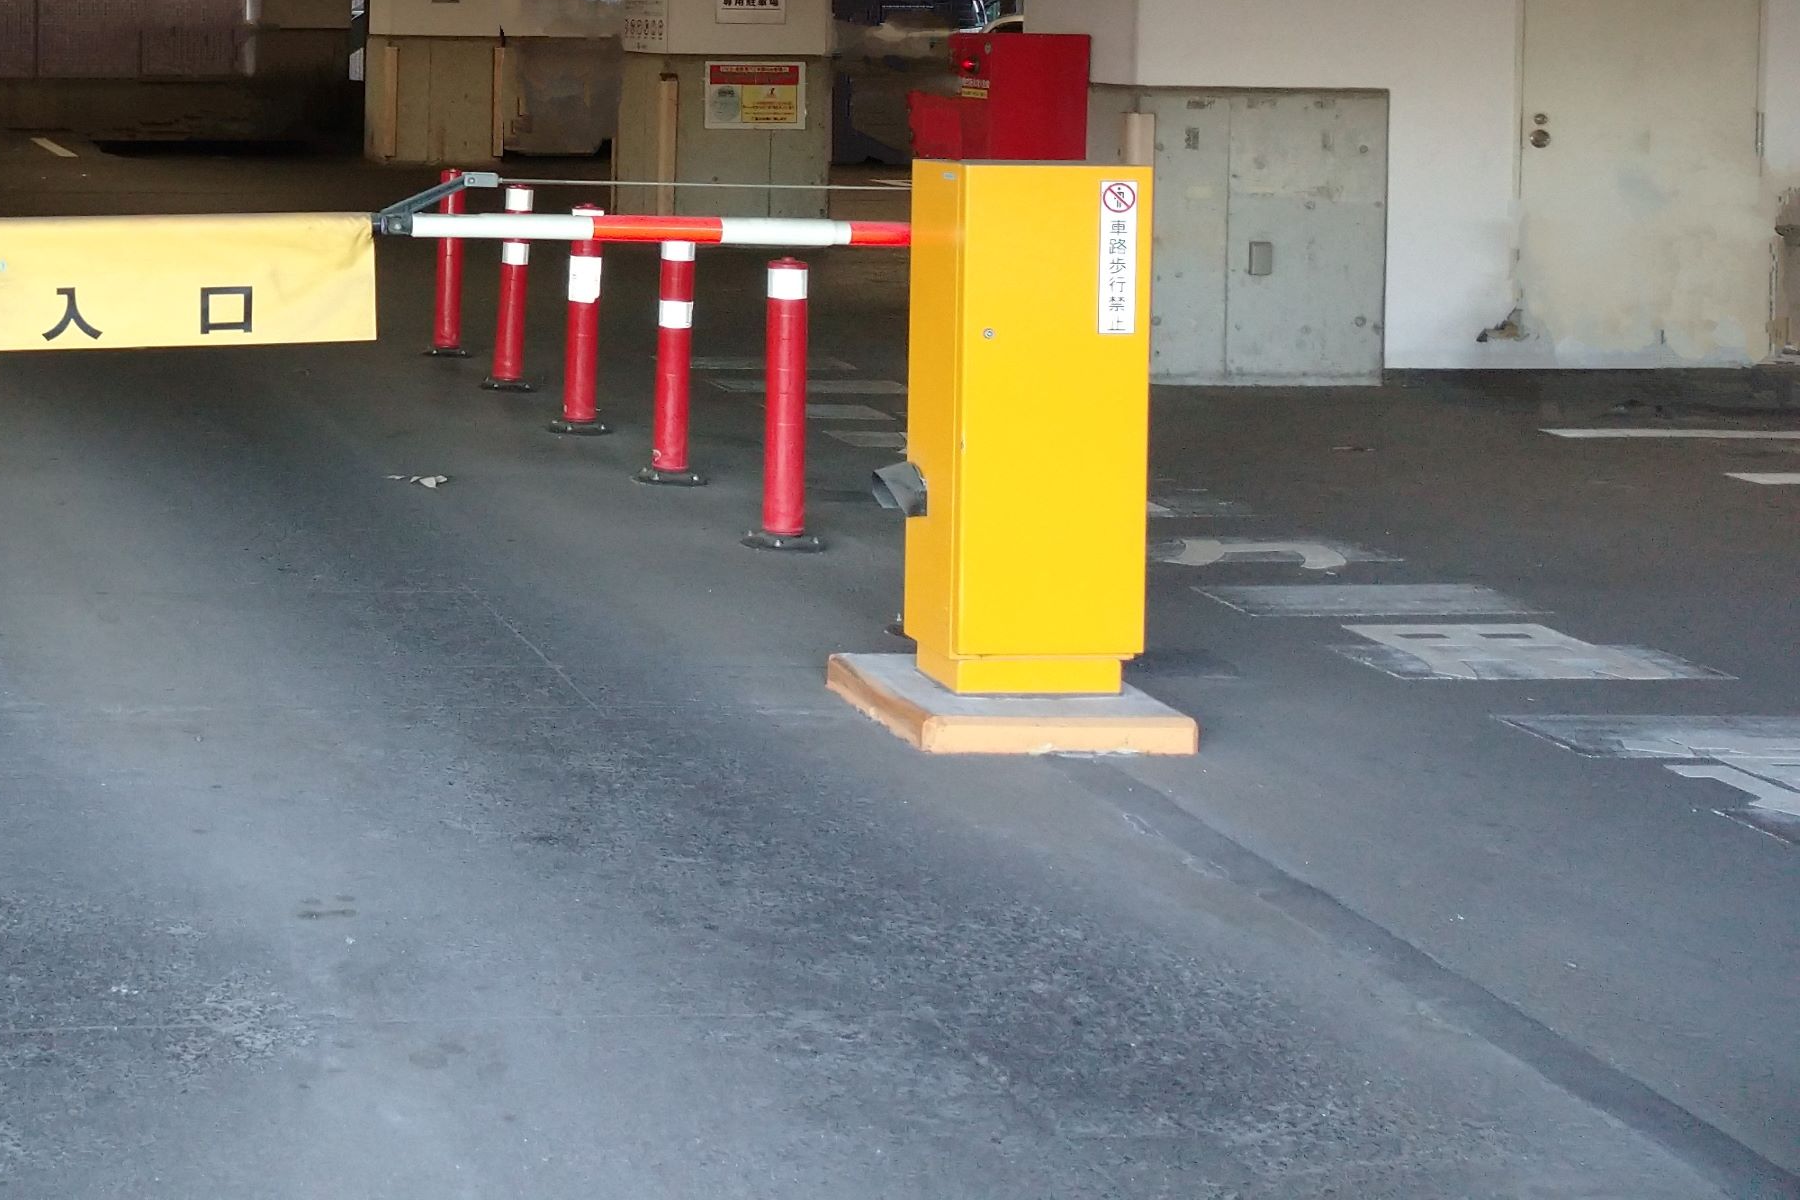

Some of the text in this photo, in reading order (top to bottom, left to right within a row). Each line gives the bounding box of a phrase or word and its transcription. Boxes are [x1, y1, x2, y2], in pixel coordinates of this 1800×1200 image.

[42, 285, 254, 342] 入口
[1109, 220, 1128, 331] 車路歩行禁止
